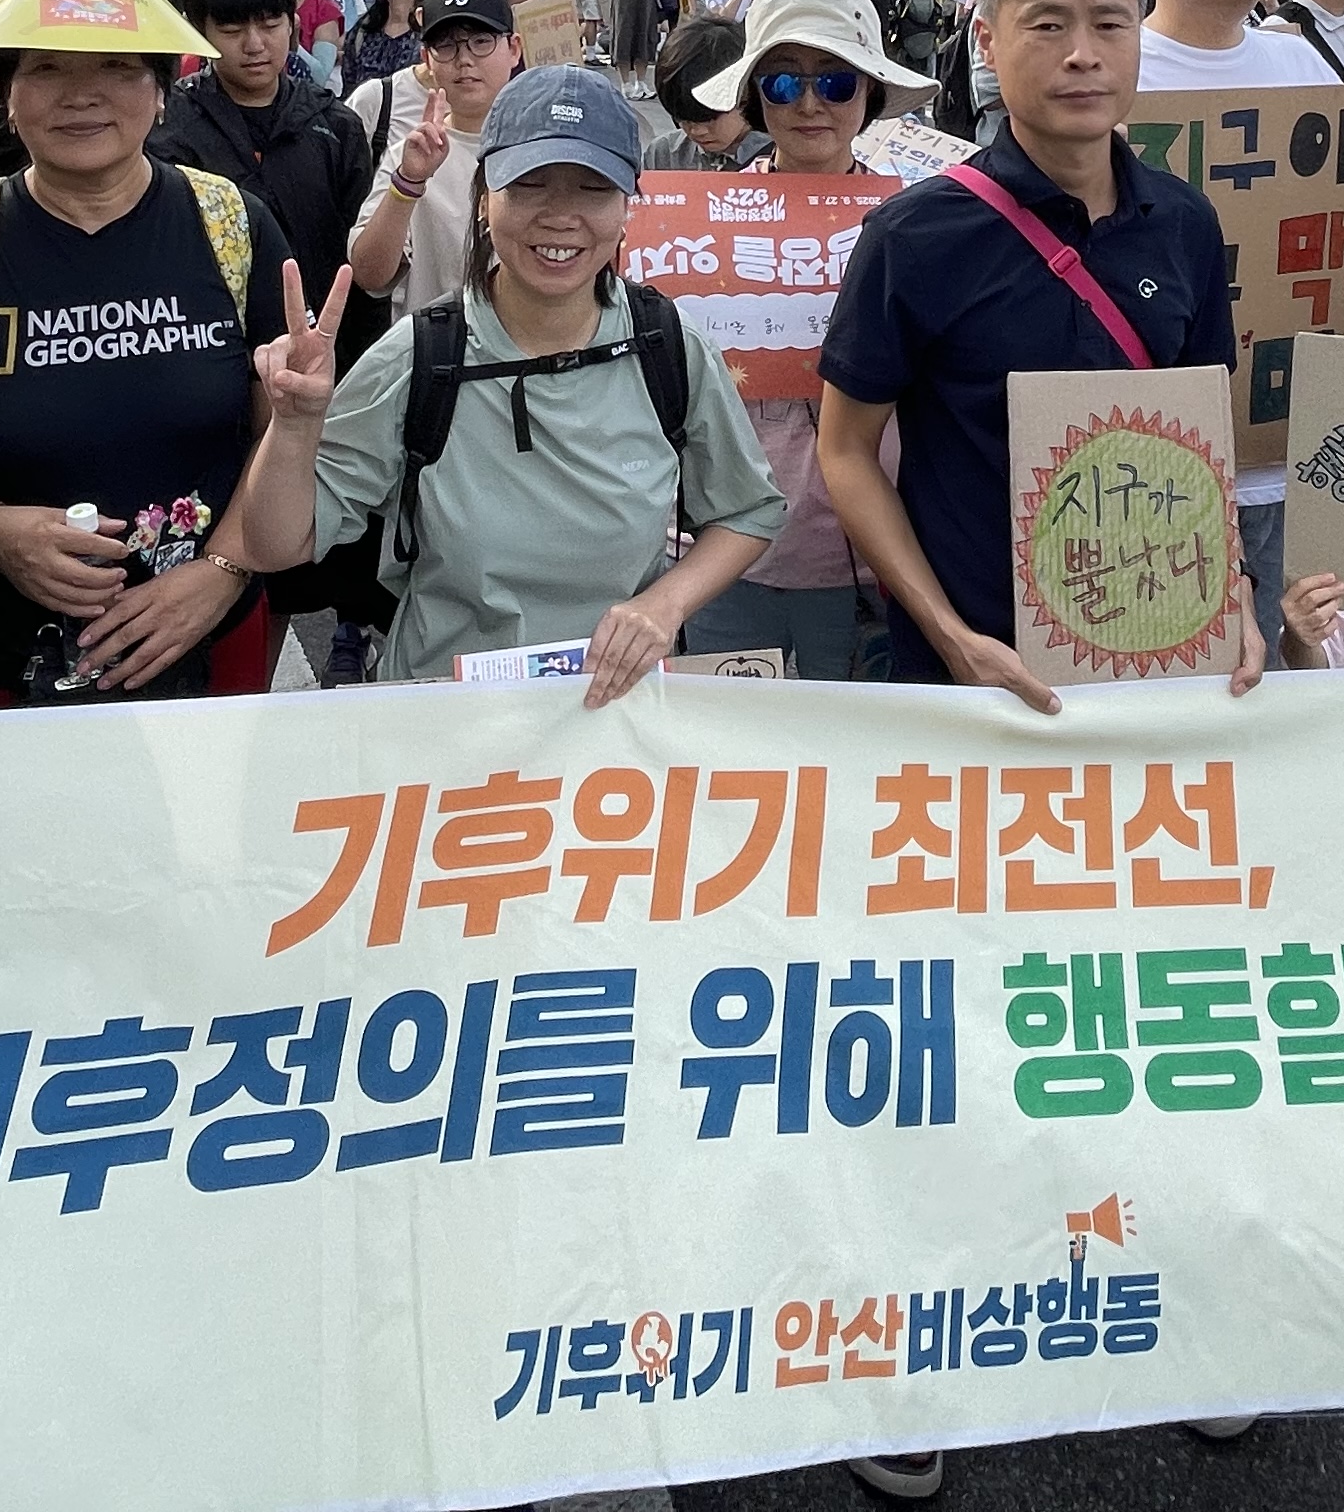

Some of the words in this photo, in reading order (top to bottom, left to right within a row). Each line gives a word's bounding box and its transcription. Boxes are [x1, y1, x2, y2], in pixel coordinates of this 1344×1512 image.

[625, 234, 719, 284] 잇자
[26, 296, 187, 337] NATIONAL
[1051, 462, 1192, 528] 지구가
[265, 764, 828, 958] 기후위기
[867, 760, 1275, 916] 최전선,
[680, 959, 957, 1140] 위해
[494, 1306, 752, 1421] 기후위기
[773, 1290, 903, 1389] 안산
[905, 1272, 1161, 1373] 비상행동
